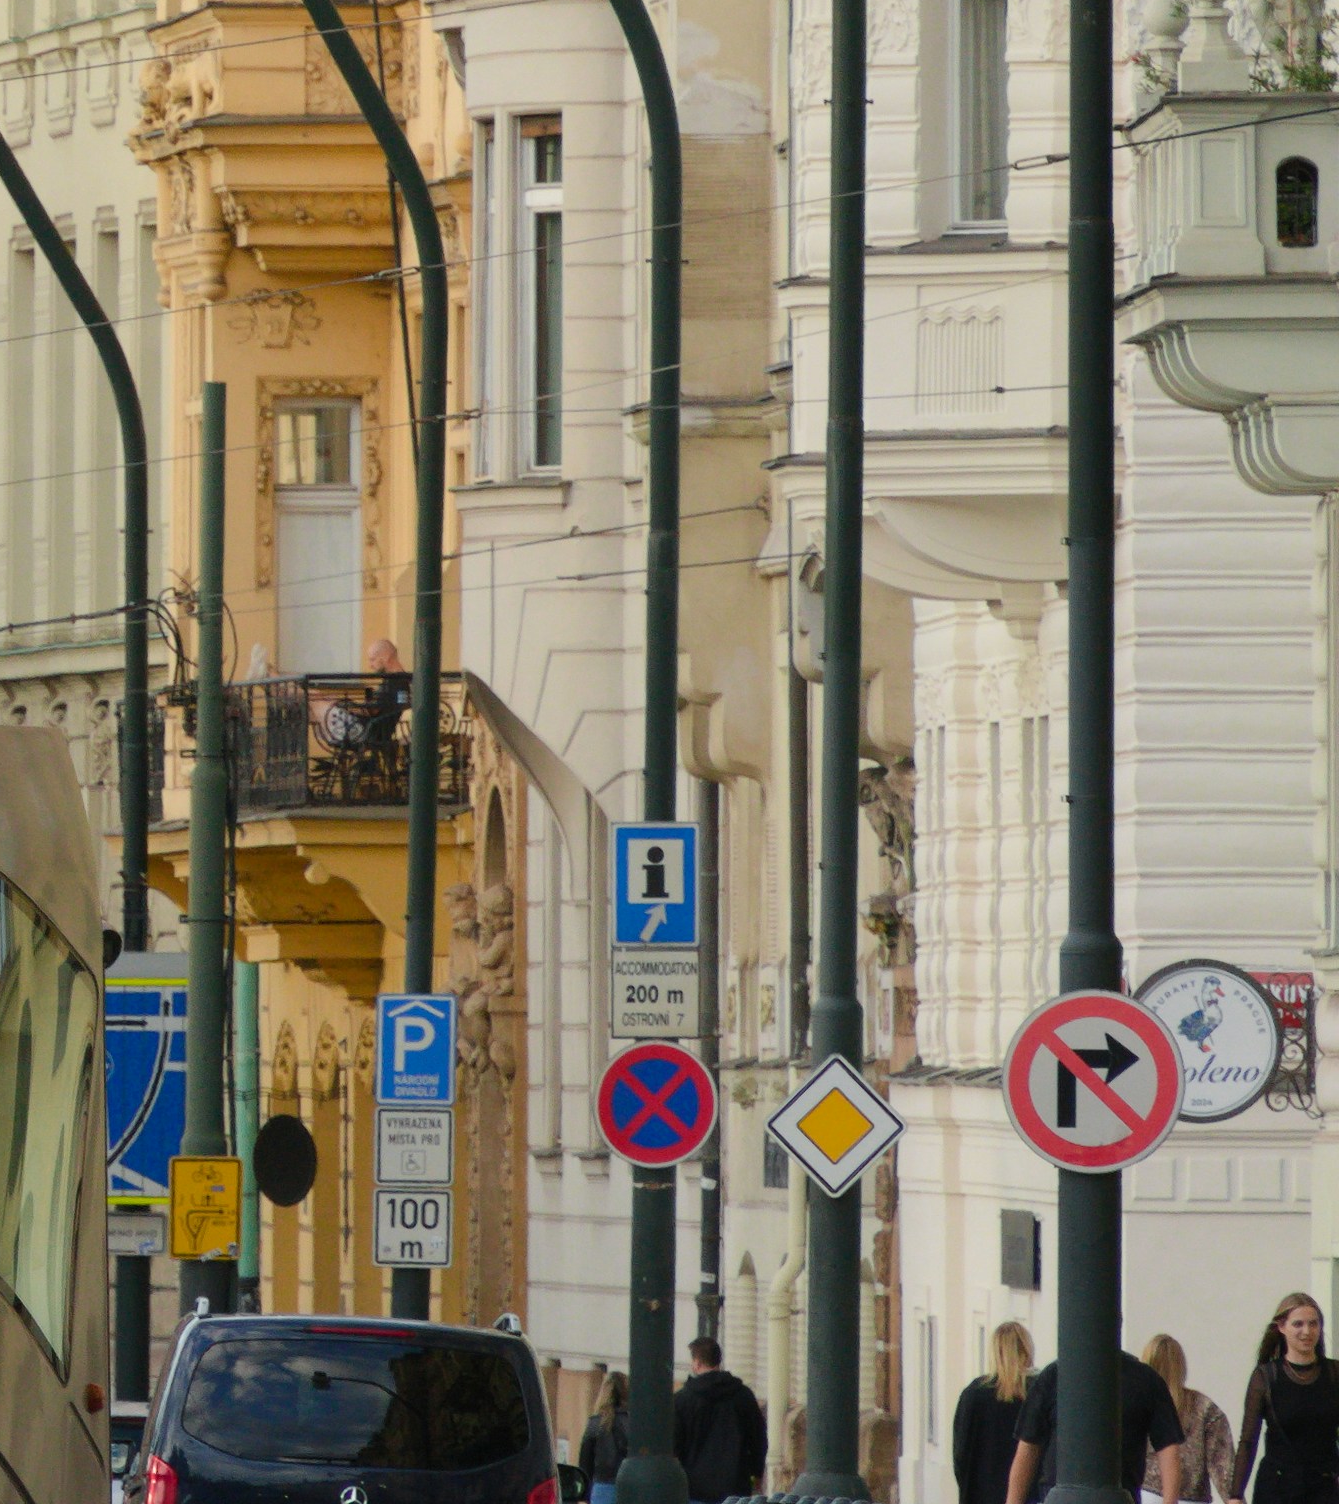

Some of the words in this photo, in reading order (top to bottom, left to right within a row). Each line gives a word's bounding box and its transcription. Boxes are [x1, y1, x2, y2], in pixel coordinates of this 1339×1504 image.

[615, 961, 698, 976] ACCOMMODATION
[626, 985, 659, 1003] 200
[667, 989, 684, 1004] m
[1152, 980, 1196, 1013] AURANT
[677, 1013, 685, 1026] 7
[1233, 989, 1266, 1034] PRAGUE
[394, 1016, 435, 1072] P
[1184, 1054, 1259, 1083] oleno
[421, 1132, 440, 1145] PRO
[387, 1198, 439, 1229] 100
[400, 1240, 423, 1259] m
